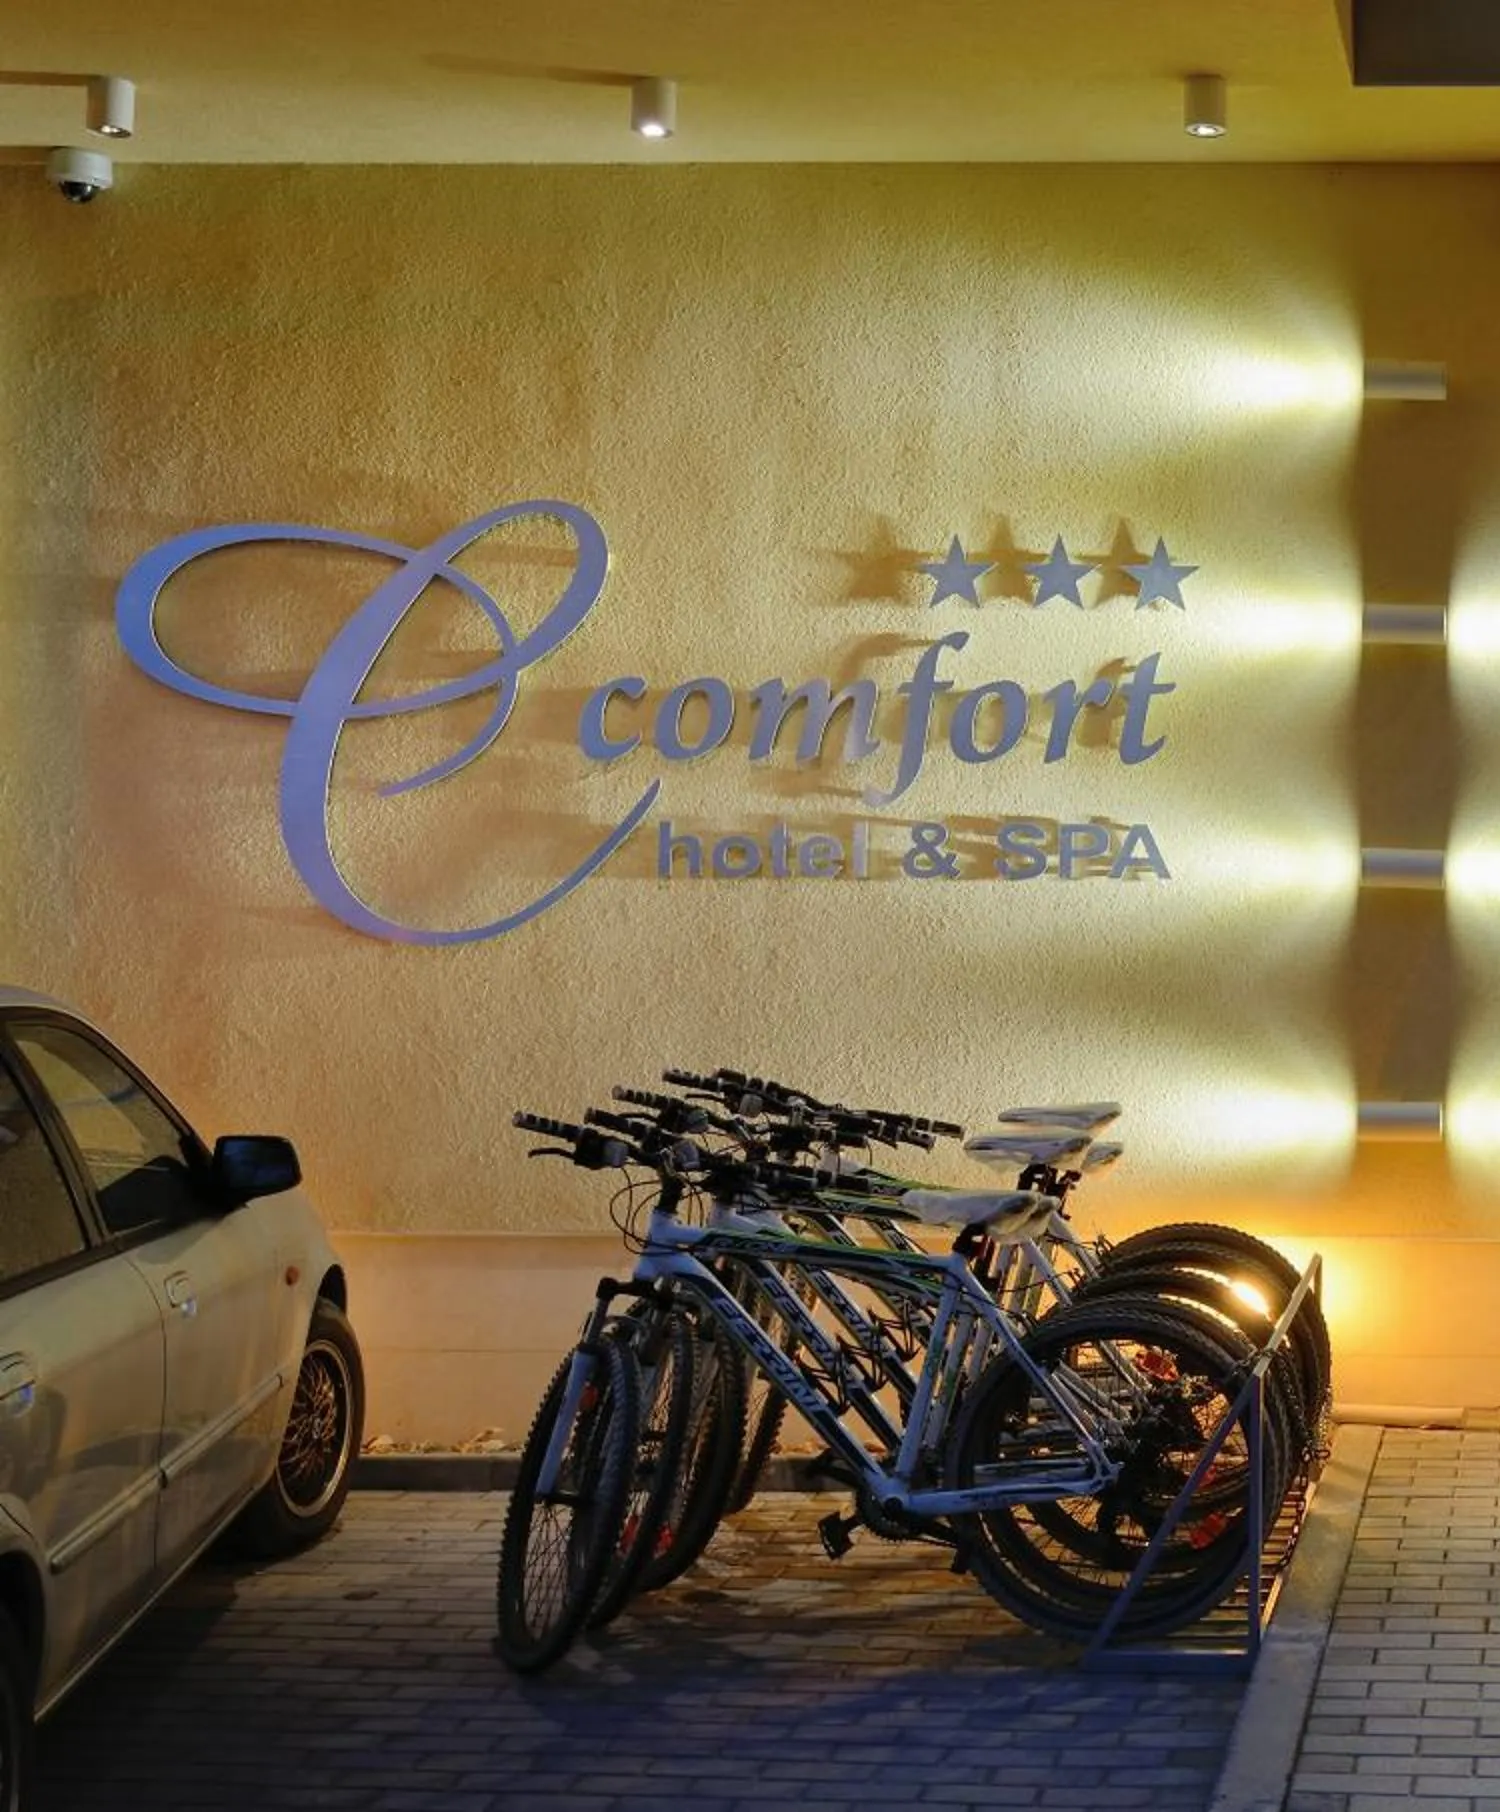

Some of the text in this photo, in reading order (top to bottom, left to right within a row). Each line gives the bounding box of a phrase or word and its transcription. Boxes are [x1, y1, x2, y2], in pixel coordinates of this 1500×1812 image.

[578, 630, 1178, 808] comfort
[657, 820, 1171, 880] hotel & SPA
